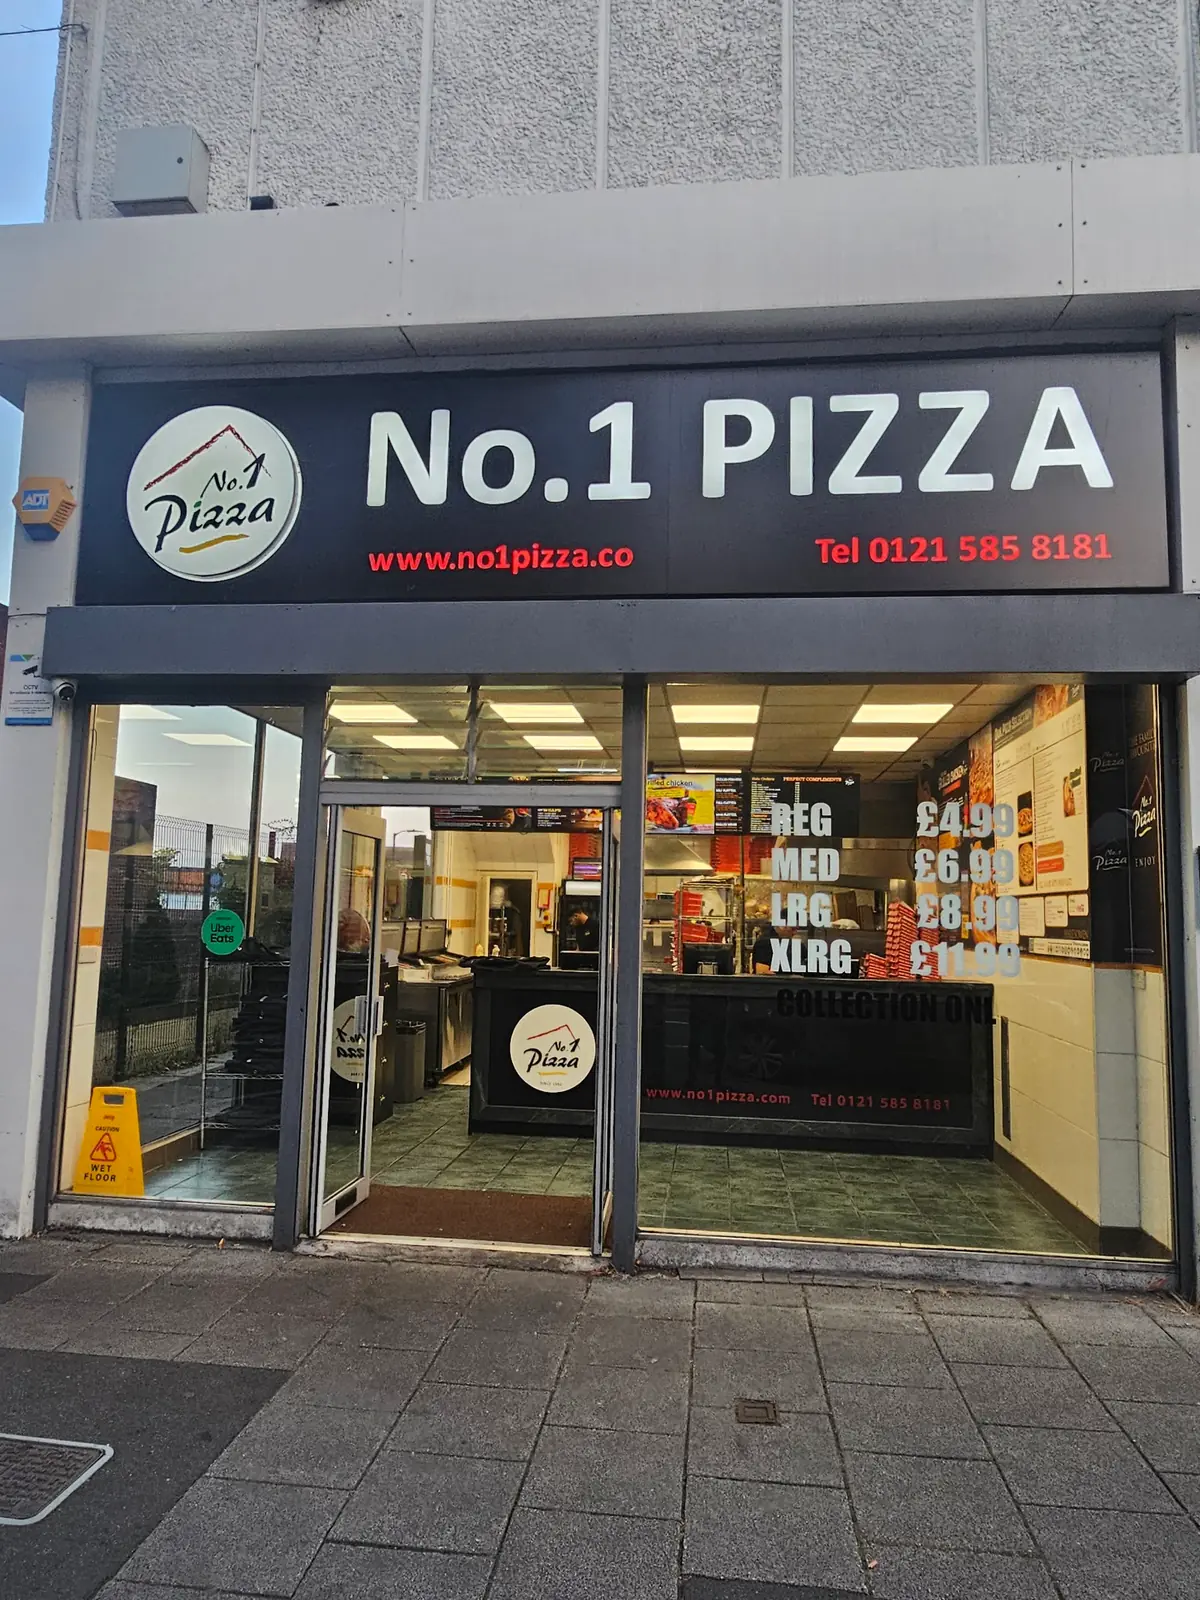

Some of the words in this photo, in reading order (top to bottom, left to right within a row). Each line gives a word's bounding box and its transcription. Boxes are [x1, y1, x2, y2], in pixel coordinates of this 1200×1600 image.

[367, 402, 651, 506] No.1
[703, 387, 1114, 498] PIZZA
[200, 453, 266, 498] No.1
[22, 493, 49, 506] ADT
[144, 495, 275, 552] Pizza
[369, 543, 634, 575] www.no1pizza.co
[815, 536, 860, 564] Tel
[868, 535, 948, 564] 0121
[958, 534, 1021, 563] 585
[1031, 532, 1112, 561] 8181
[1089, 757, 1125, 773] Pizza
[771, 803, 832, 836] REG
[917, 801, 1014, 837] £4.99
[1132, 806, 1156, 838] Pizza
[772, 848, 840, 882] MED
[914, 848, 1014, 883] £6.99
[1092, 855, 1128, 871] Pizza
[1135, 855, 1155, 868] ENJOY
[771, 893, 833, 927] LRG
[917, 893, 1019, 930] £8.99
[210, 923, 236, 933] Uber
[210, 934, 234, 943] Eats
[770, 938, 852, 974] XLRG
[909, 940, 1021, 977] £11.99
[777, 988, 937, 1022] COLLECTION
[523, 1047, 579, 1073] Pizza
[548, 1038, 581, 1053] No.1
[646, 1087, 791, 1106] www.no1pizza.com
[811, 1093, 832, 1107] Tel
[838, 1095, 873, 1109] 0121
[880, 1097, 907, 1110] 585
[913, 1099, 950, 1111] 8181
[83, 1172, 117, 1183] FLOOR
[91, 1163, 112, 1173] WET
